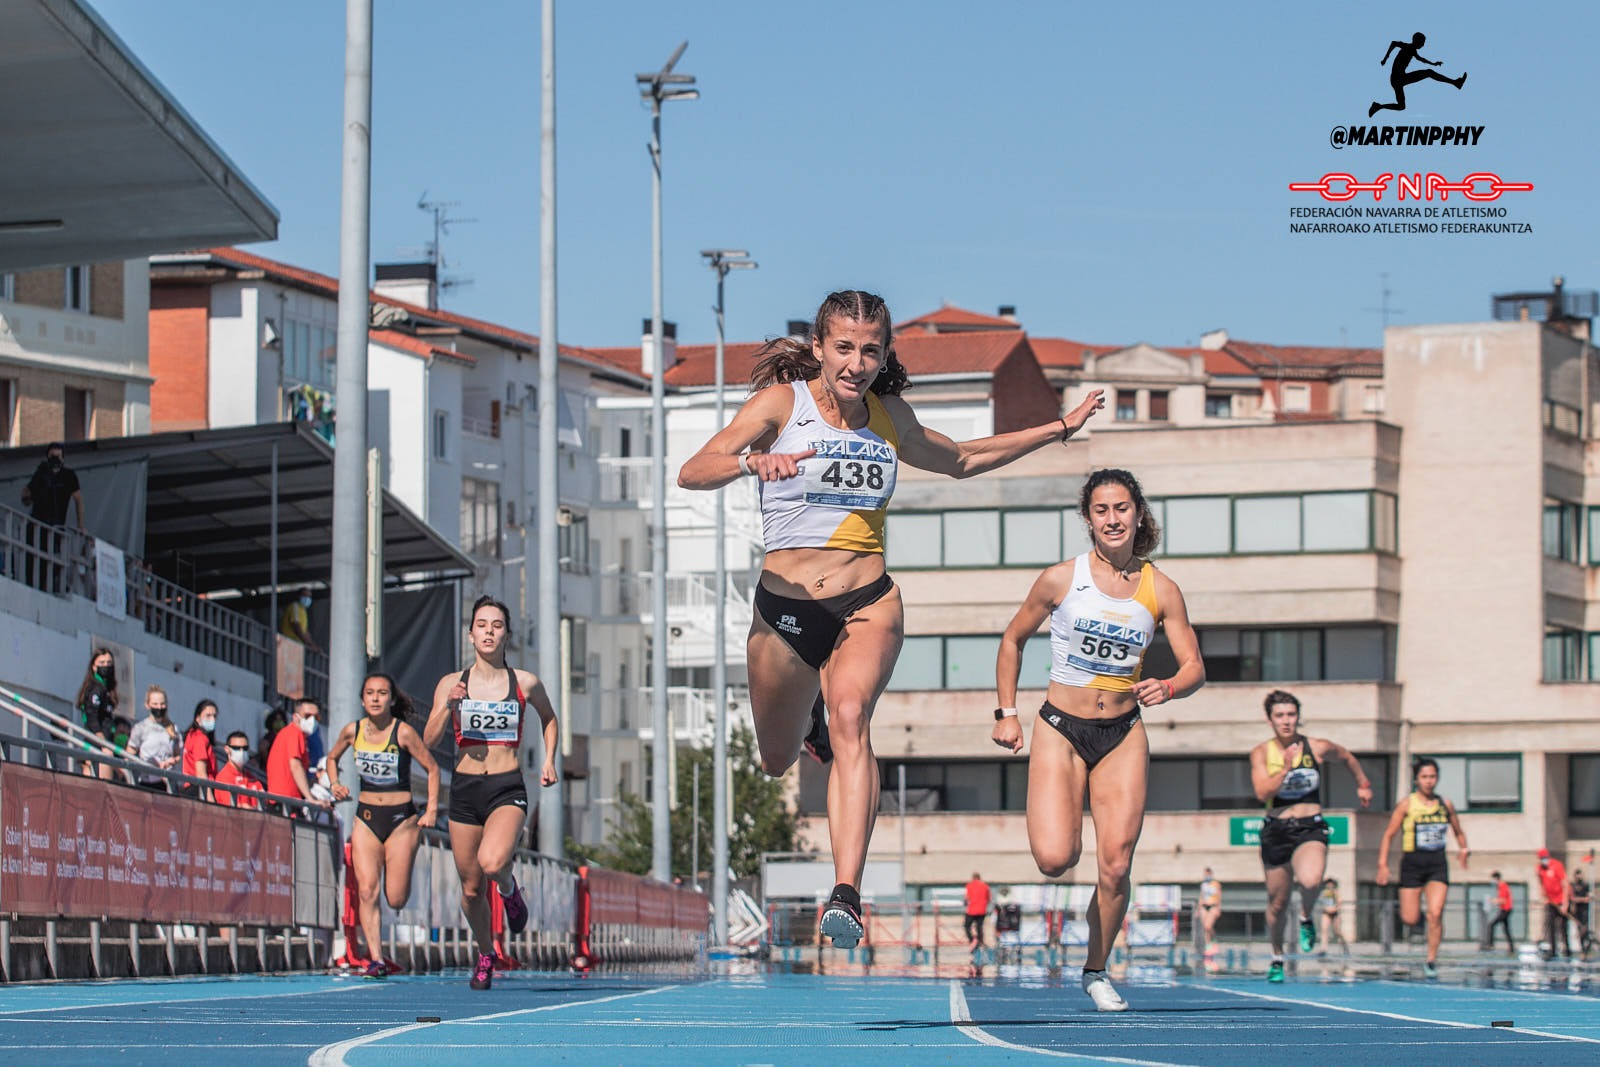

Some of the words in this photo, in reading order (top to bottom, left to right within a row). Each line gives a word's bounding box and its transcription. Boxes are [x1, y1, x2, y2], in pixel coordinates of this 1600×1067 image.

[821, 461, 884, 490] 438
[1081, 636, 1130, 661] 563
[470, 714, 509, 730] 623
[362, 761, 391, 776] 262
